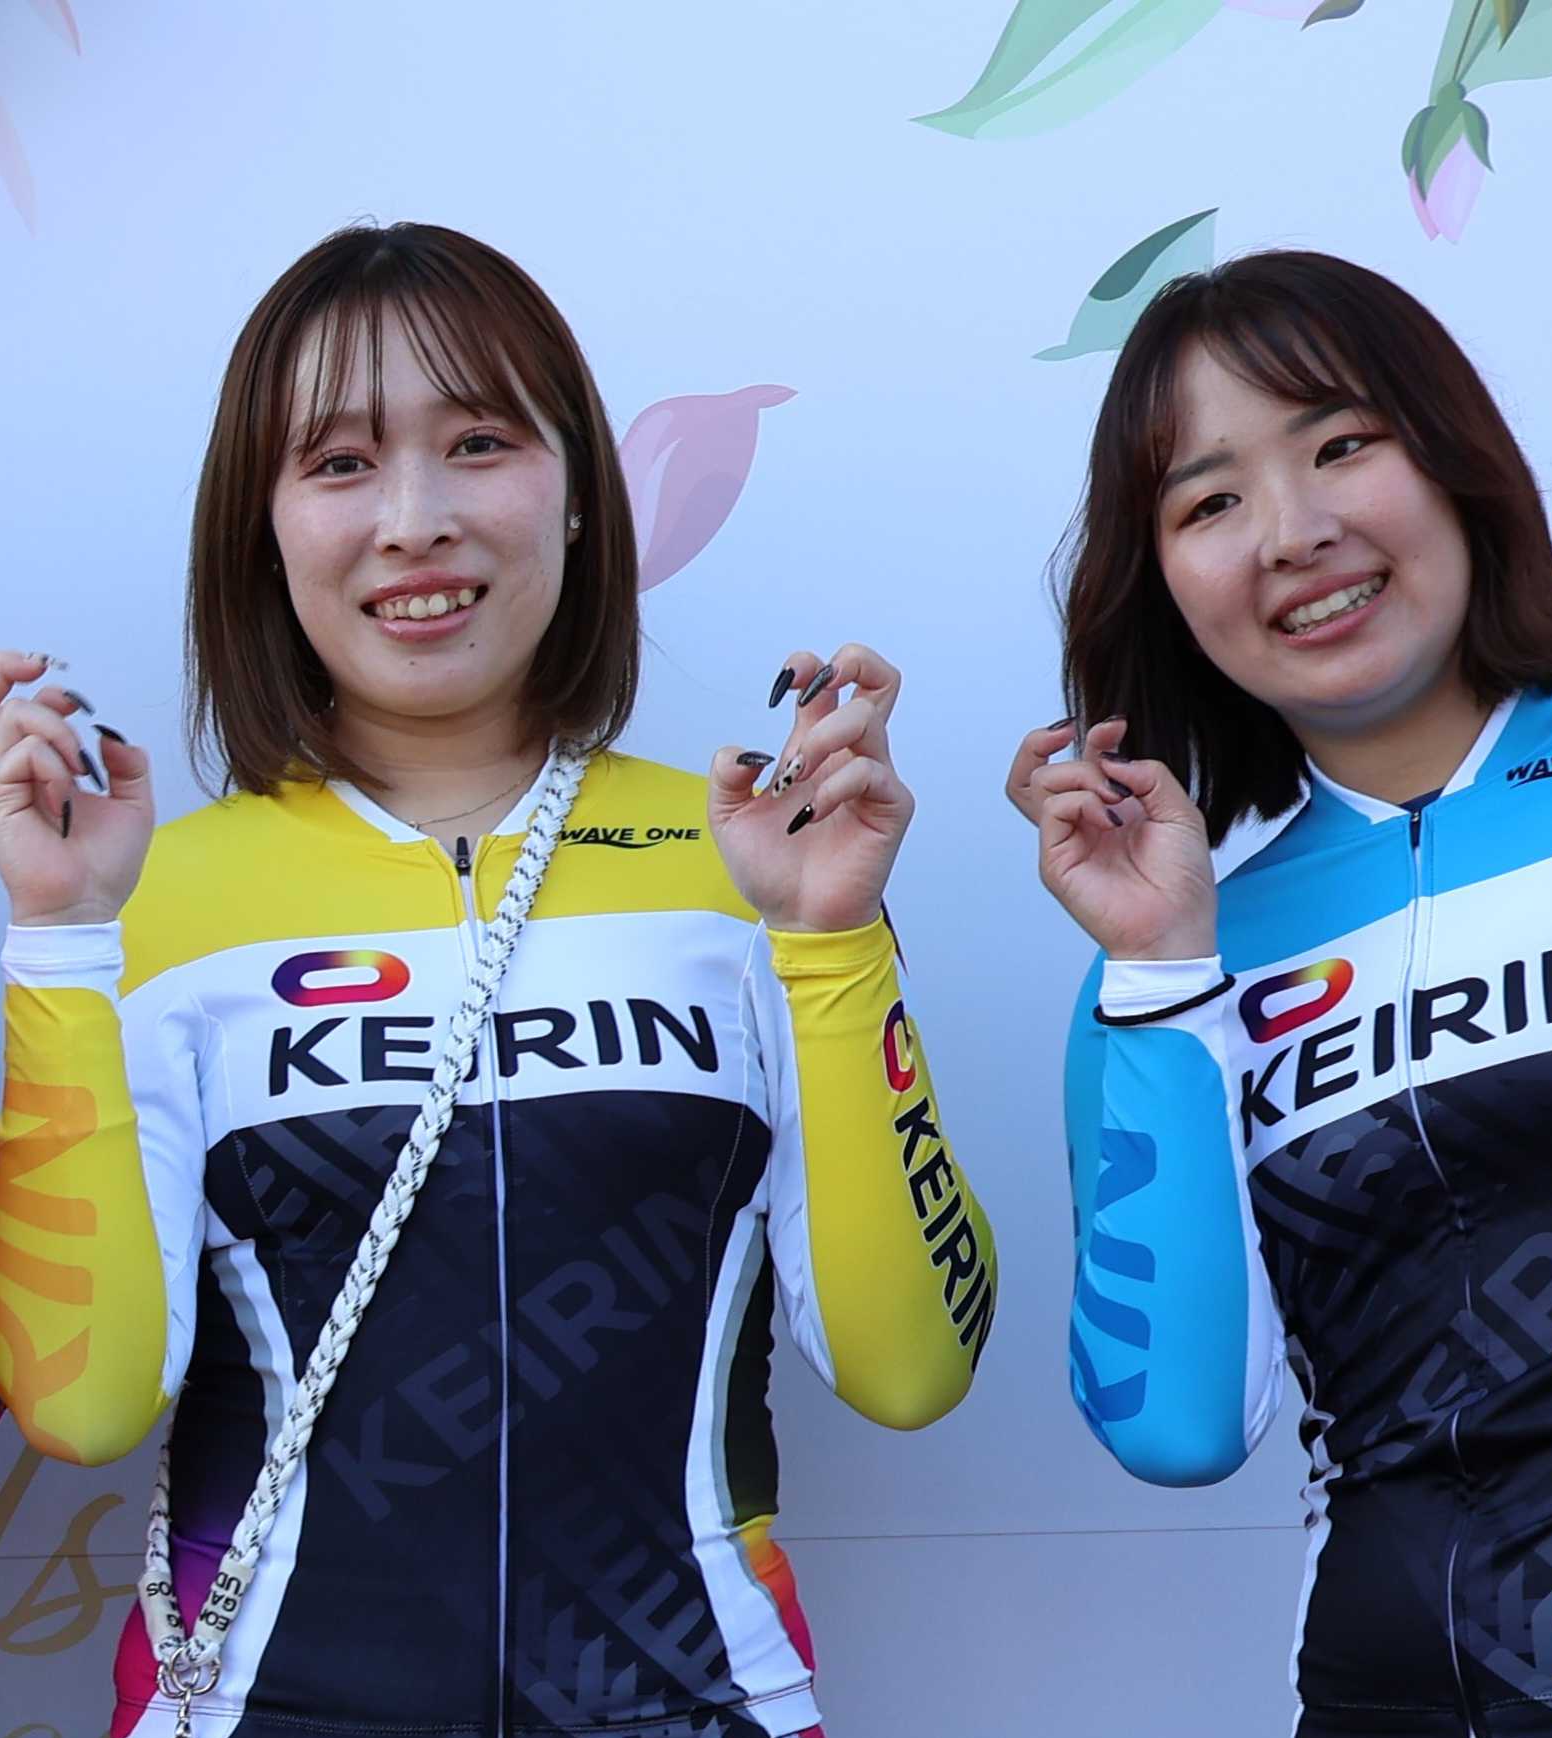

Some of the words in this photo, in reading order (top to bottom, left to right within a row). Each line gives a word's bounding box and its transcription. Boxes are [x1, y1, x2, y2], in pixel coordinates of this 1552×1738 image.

[558, 827, 635, 844] WAVE
[645, 827, 701, 842] ONE
[268, 997, 720, 1098] KERIN
[894, 1095, 996, 1375] KEIRIN
